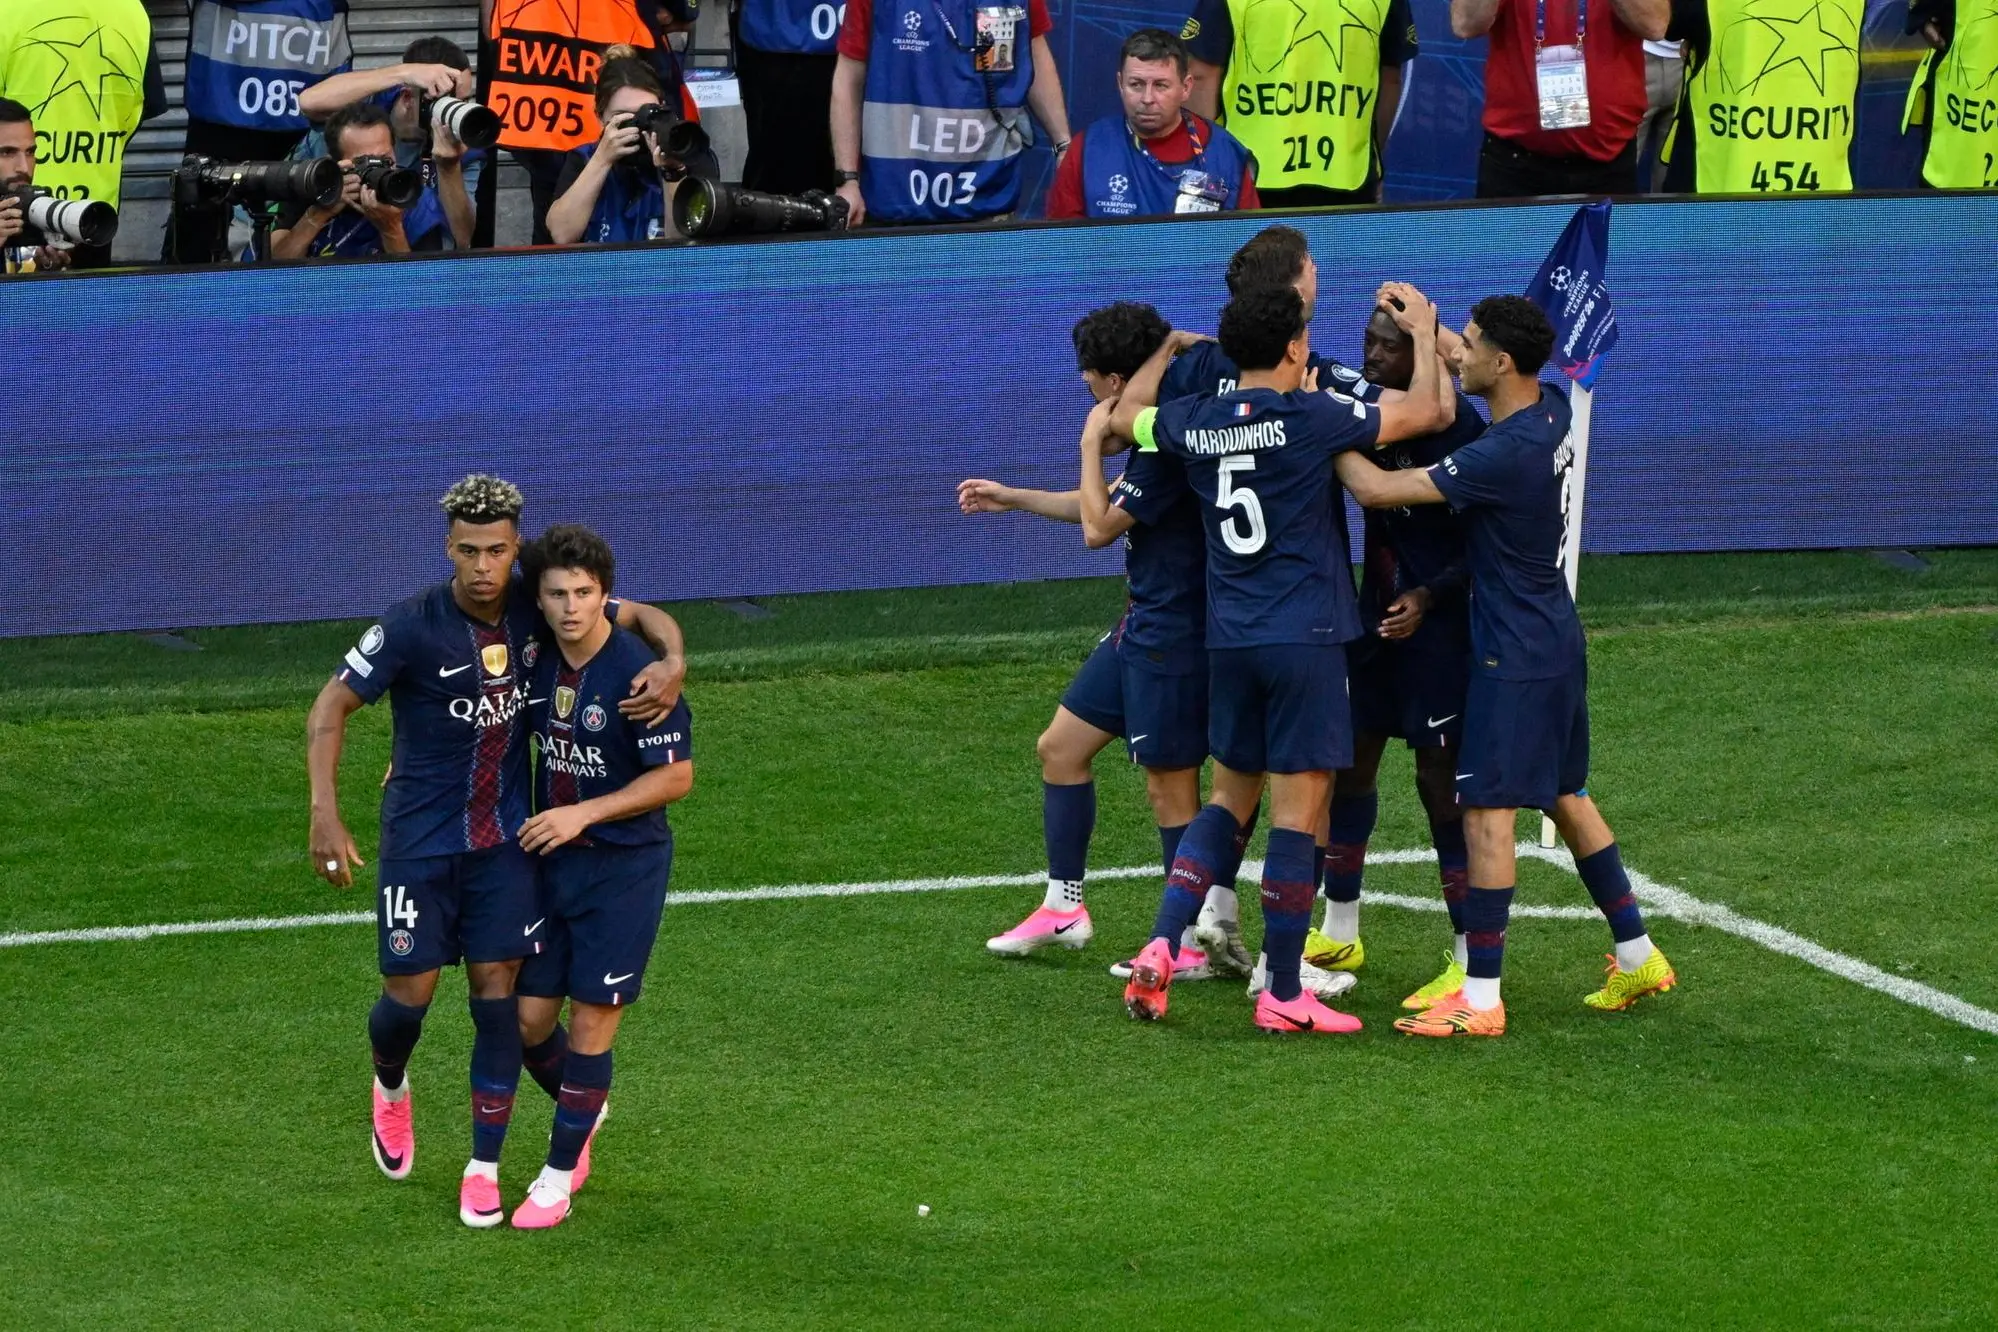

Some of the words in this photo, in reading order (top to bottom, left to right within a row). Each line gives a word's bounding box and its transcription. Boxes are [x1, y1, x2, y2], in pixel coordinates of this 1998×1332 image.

[225, 19, 330, 66] PITCH
[892, 38, 930, 47] CHAMPIONS
[239, 77, 305, 117] 085
[496, 93, 583, 136] 2095
[1946, 92, 1998, 133] SEC
[910, 114, 985, 153] LED
[1282, 135, 1334, 172] 219
[910, 169, 977, 208] 003
[1751, 161, 1820, 192] 454
[1096, 200, 1137, 210] CHAMPIONS
[1563, 269, 1590, 318] CHAMPIONS
[1571, 283, 1590, 315] LEAGUE
[1185, 420, 1287, 455] MARQUINHOS
[1216, 454, 1267, 554] 5
[474, 701, 526, 729] AIRW
[532, 731, 605, 764] QATAR
[638, 732, 682, 749] EYOND
[545, 756, 607, 778] AIRWAYS
[384, 886, 418, 928] 14
